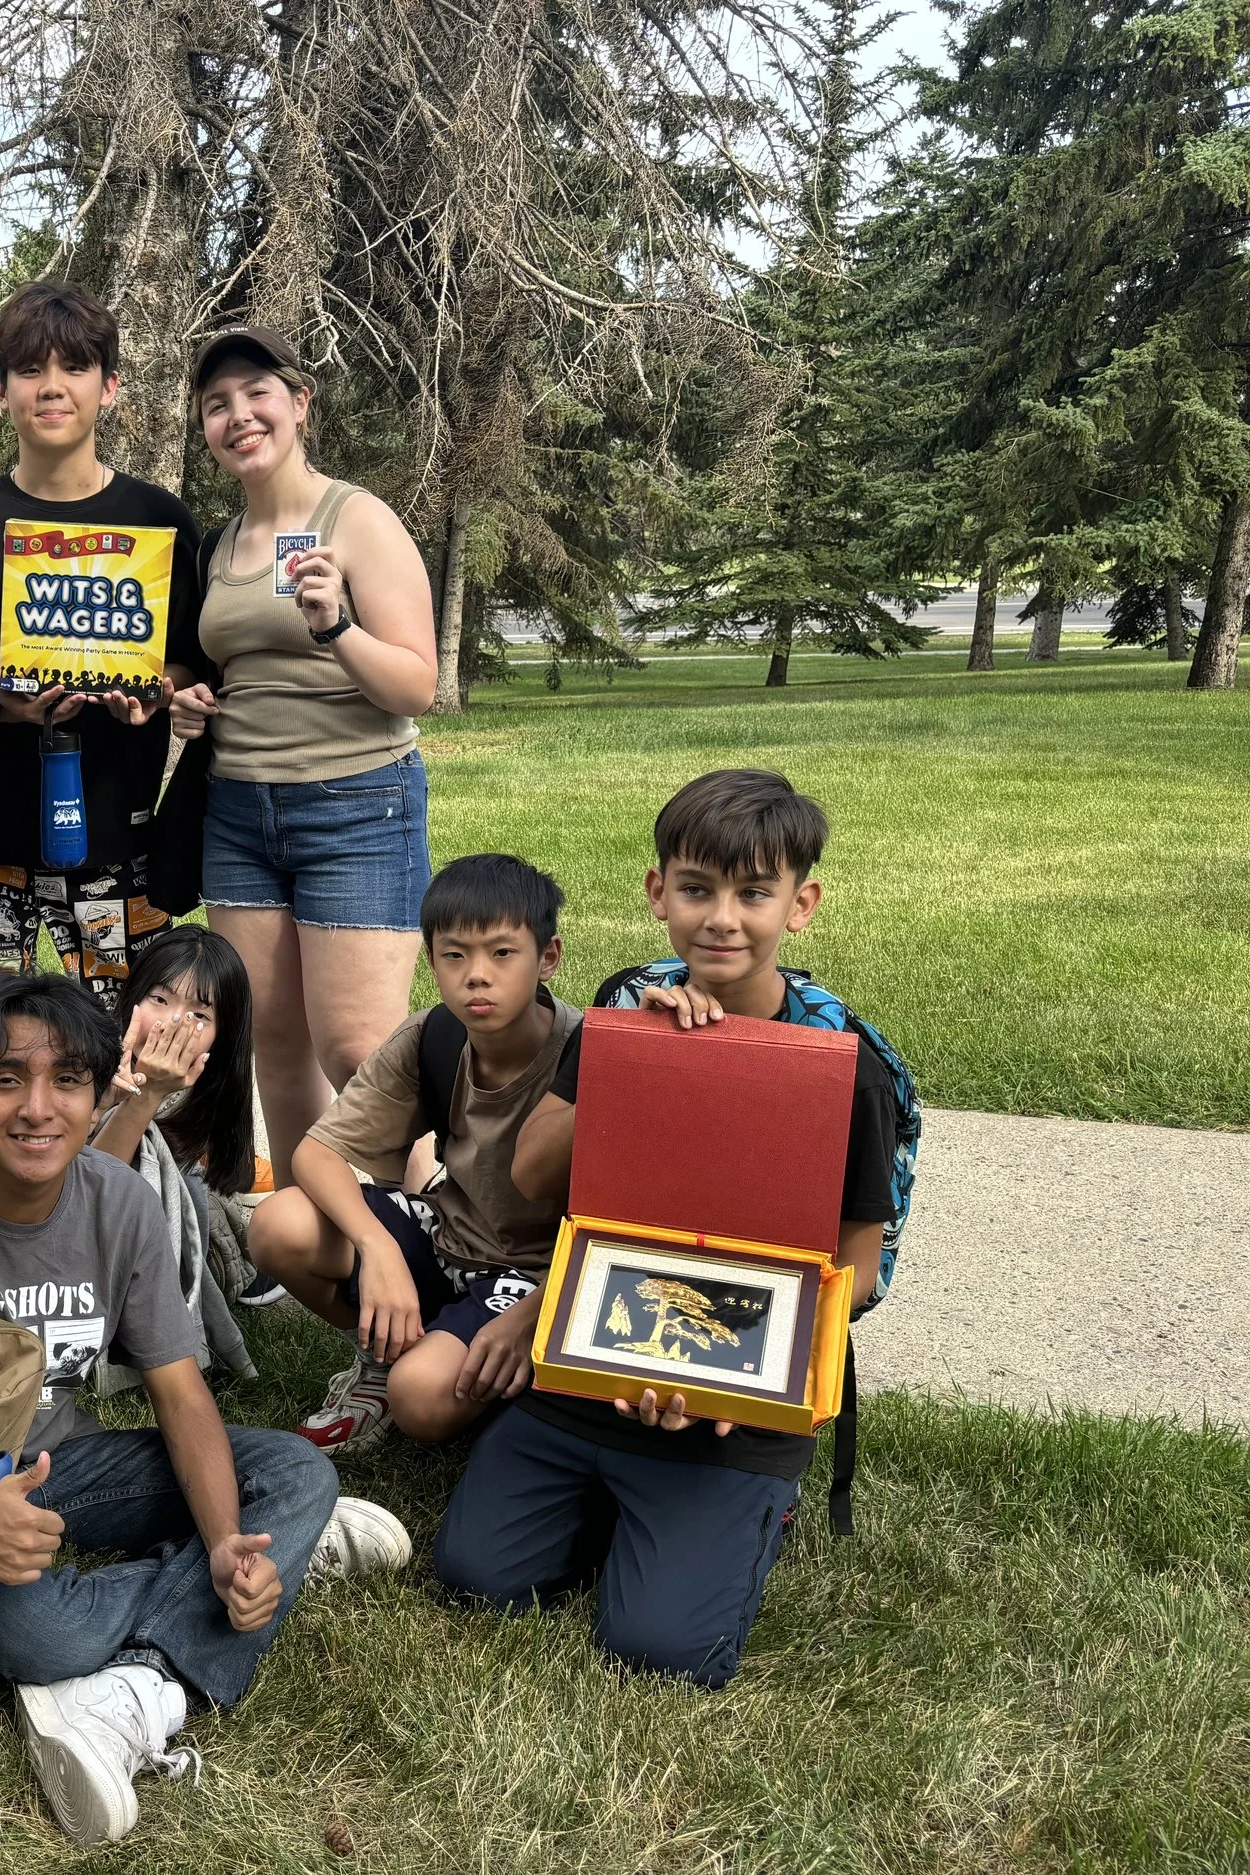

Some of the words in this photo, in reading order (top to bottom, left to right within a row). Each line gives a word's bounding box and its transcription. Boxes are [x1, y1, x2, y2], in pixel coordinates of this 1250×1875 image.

[278, 538, 314, 557] BICYCLE
[28, 576, 111, 608] WITS
[118, 580, 140, 609] &
[17, 604, 149, 638] WAGERS
